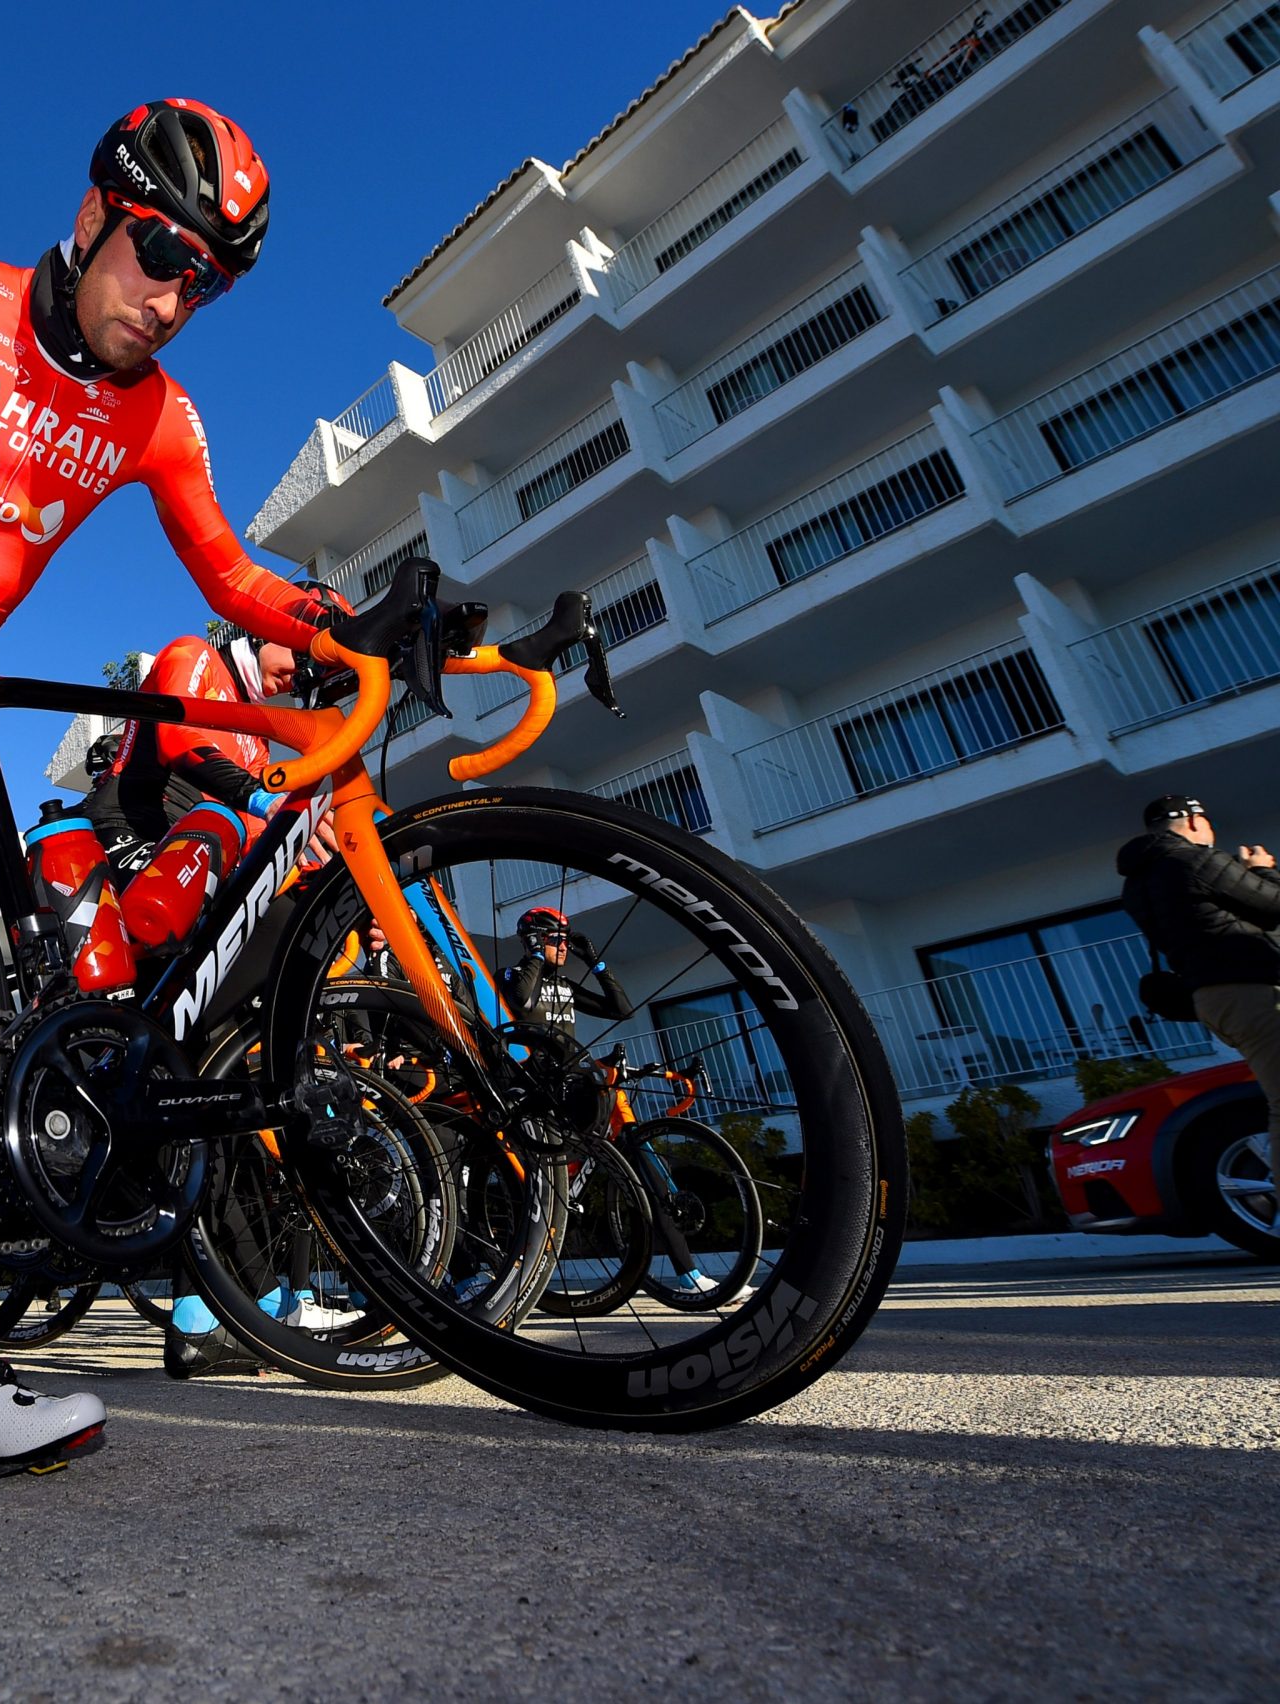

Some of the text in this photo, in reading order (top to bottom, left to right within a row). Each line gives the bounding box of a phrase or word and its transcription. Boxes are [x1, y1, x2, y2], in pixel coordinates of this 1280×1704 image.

[116, 143, 158, 192] RUDY
[422, 798, 491, 817] CONTINENTAL
[175, 774, 333, 1041] MERIDA
[607, 852, 799, 1010] metron
[158, 1093, 242, 1106] DURA-ACE
[1067, 1159, 1126, 1179] MERIDA
[420, 1199, 441, 1267] Vision
[844, 1225, 884, 1327] COMPETITION
[336, 1346, 431, 1372] Vision
[626, 1279, 820, 1398] Vision
